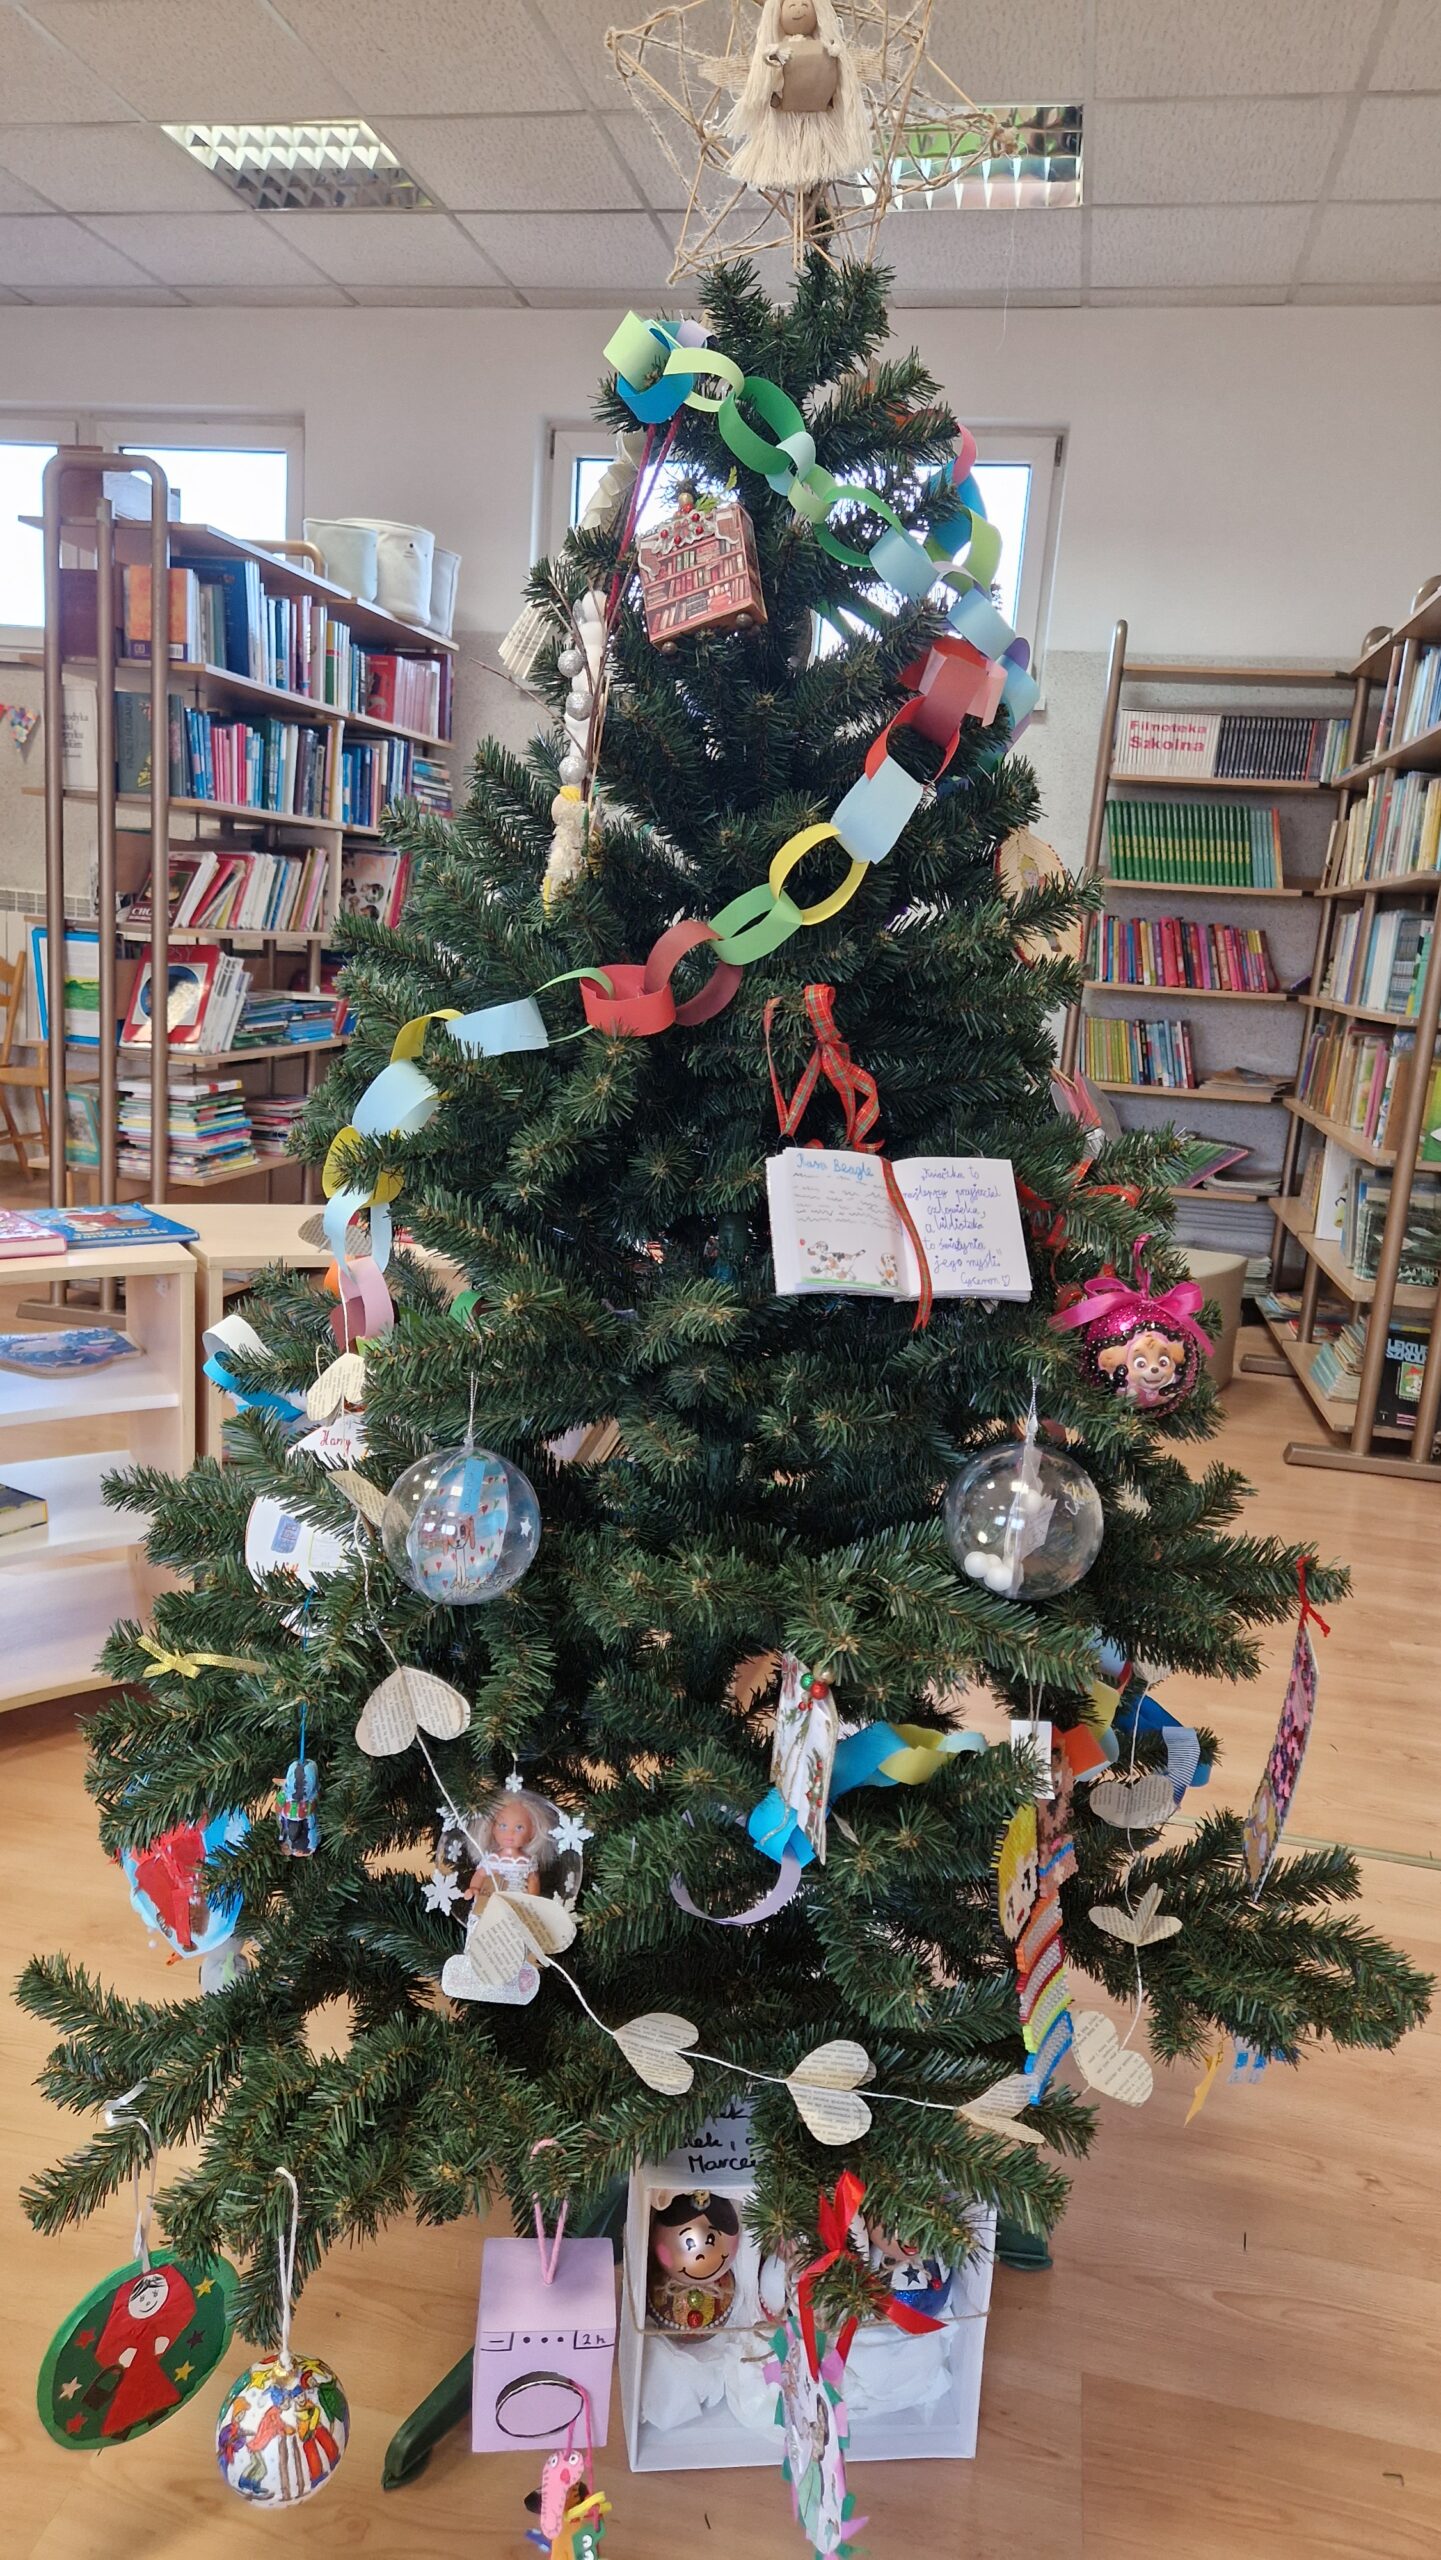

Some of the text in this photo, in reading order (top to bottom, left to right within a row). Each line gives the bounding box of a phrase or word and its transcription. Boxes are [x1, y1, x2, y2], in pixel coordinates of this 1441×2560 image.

[1129, 720, 1208, 734] Filmoteka
[1129, 735, 1206, 752] Szkolna
[833, 1159, 874, 1181] Beagle
[968, 1164, 980, 1179] to
[925, 1223, 936, 1234] a
[923, 1236, 936, 1250] to
[934, 1255, 963, 1274] jego
